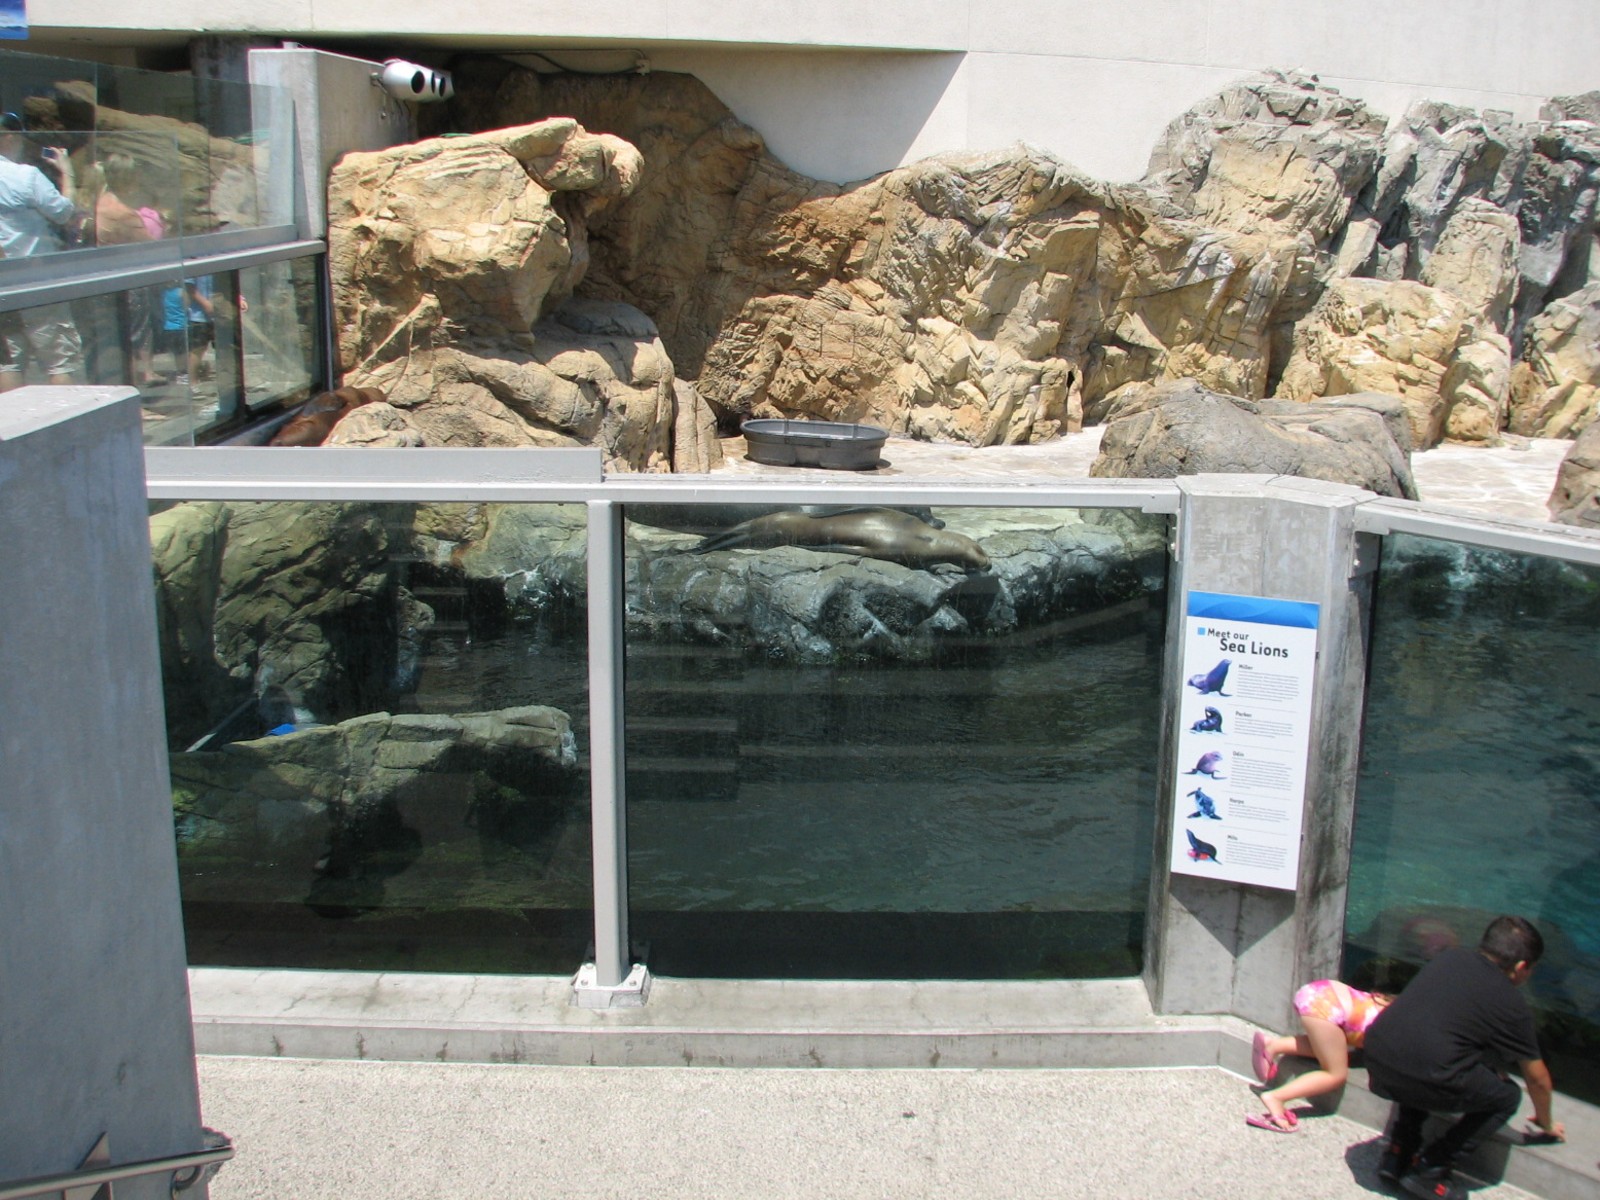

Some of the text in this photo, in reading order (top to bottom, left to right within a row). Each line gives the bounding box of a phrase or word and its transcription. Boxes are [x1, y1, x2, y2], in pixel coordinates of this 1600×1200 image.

[1207, 628, 1249, 640] Meet our
[1220, 638, 1288, 658] Sea Lions
